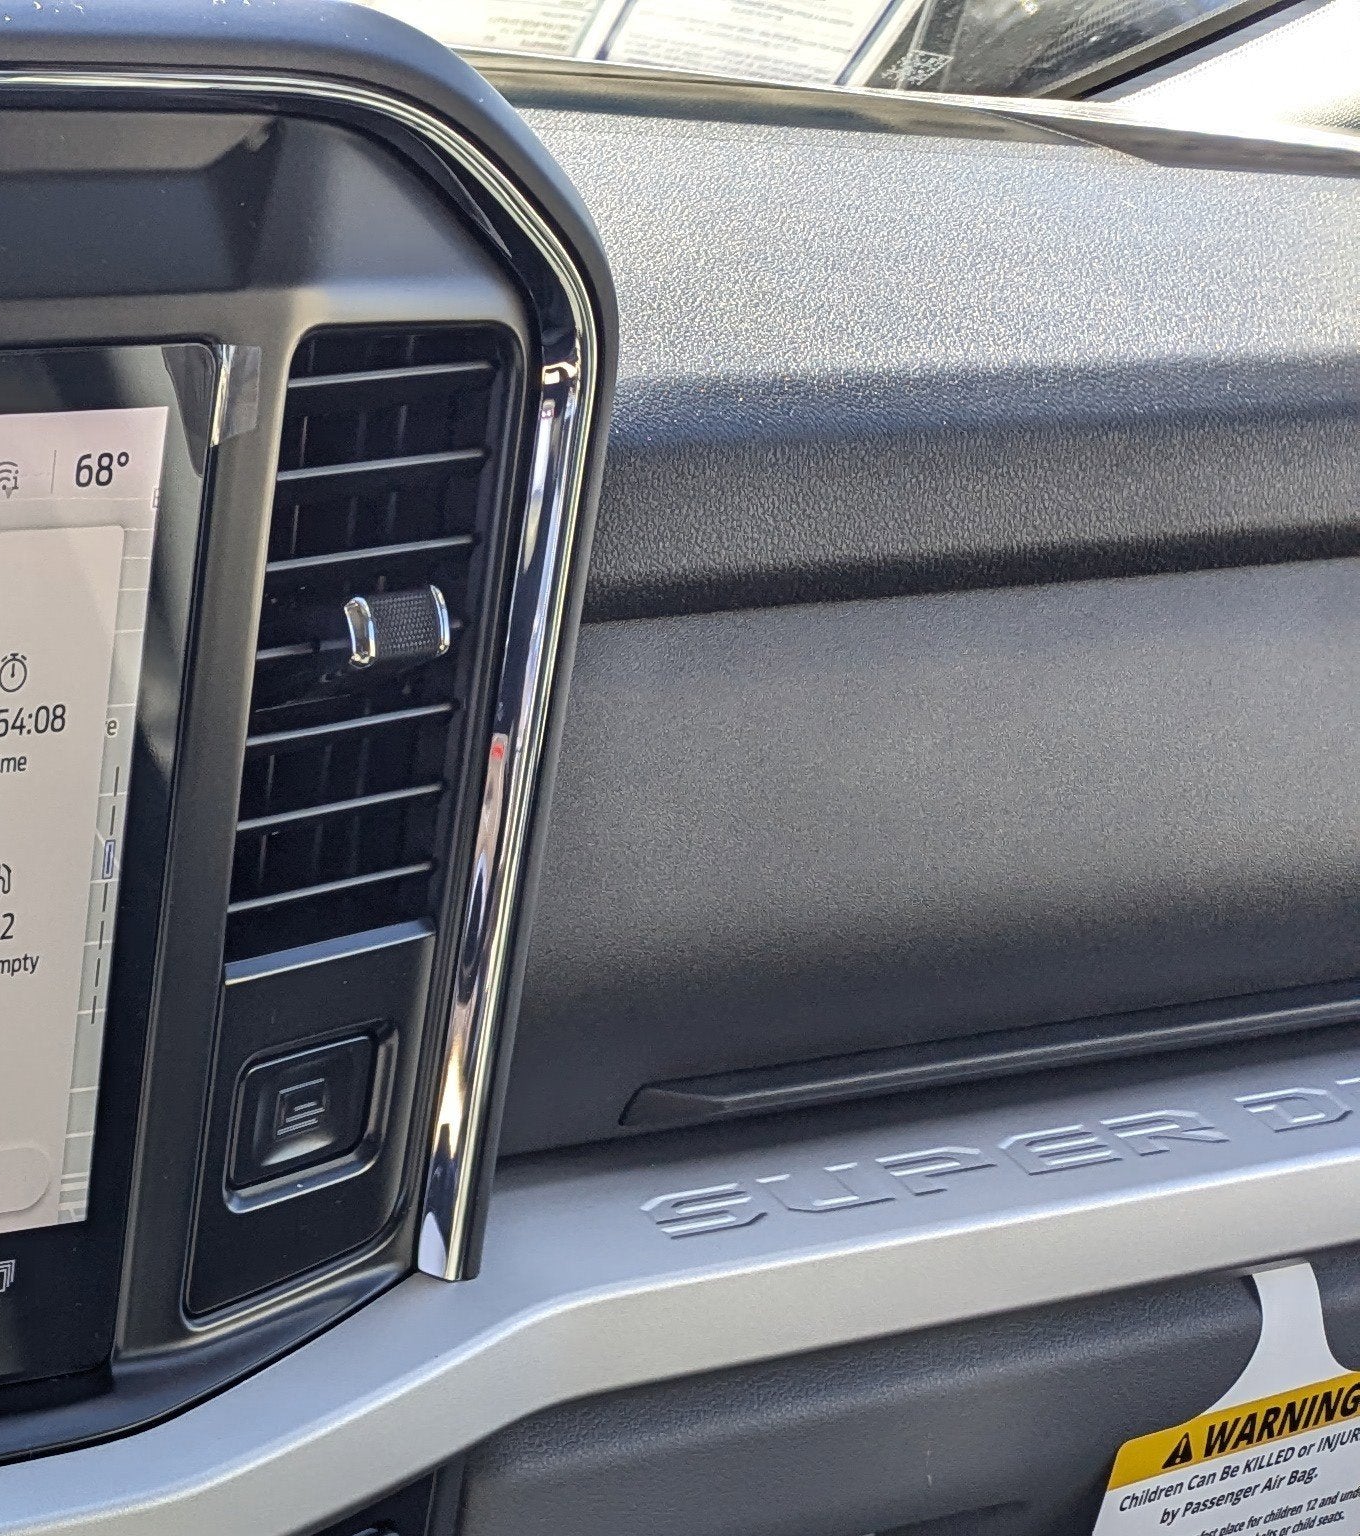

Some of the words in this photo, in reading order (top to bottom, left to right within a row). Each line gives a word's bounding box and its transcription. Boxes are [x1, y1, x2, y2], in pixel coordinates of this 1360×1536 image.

[74, 450, 130, 488] 68°
[639, 1108, 1230, 1240] SUPER
[1203, 1381, 1360, 1459] WARNING
[1118, 1480, 1184, 1512] Children
[1187, 1473, 1216, 1492] Can
[1219, 1464, 1240, 1482] Be
[1242, 1446, 1296, 1475] KILLED
[1297, 1442, 1316, 1458] or
[1159, 1507, 1181, 1527] by
[1182, 1482, 1261, 1518] Passenger
[1260, 1474, 1287, 1494] Air
[1286, 1466, 1319, 1485] Bag.
[1246, 1514, 1264, 1530] for
[1263, 1503, 1304, 1525] children
[1305, 1497, 1320, 1513] 12
[1318, 1490, 1341, 1508] and
[1339, 1485, 1360, 1503] und
[1278, 1524, 1292, 1536] or
[1291, 1516, 1317, 1534] child
